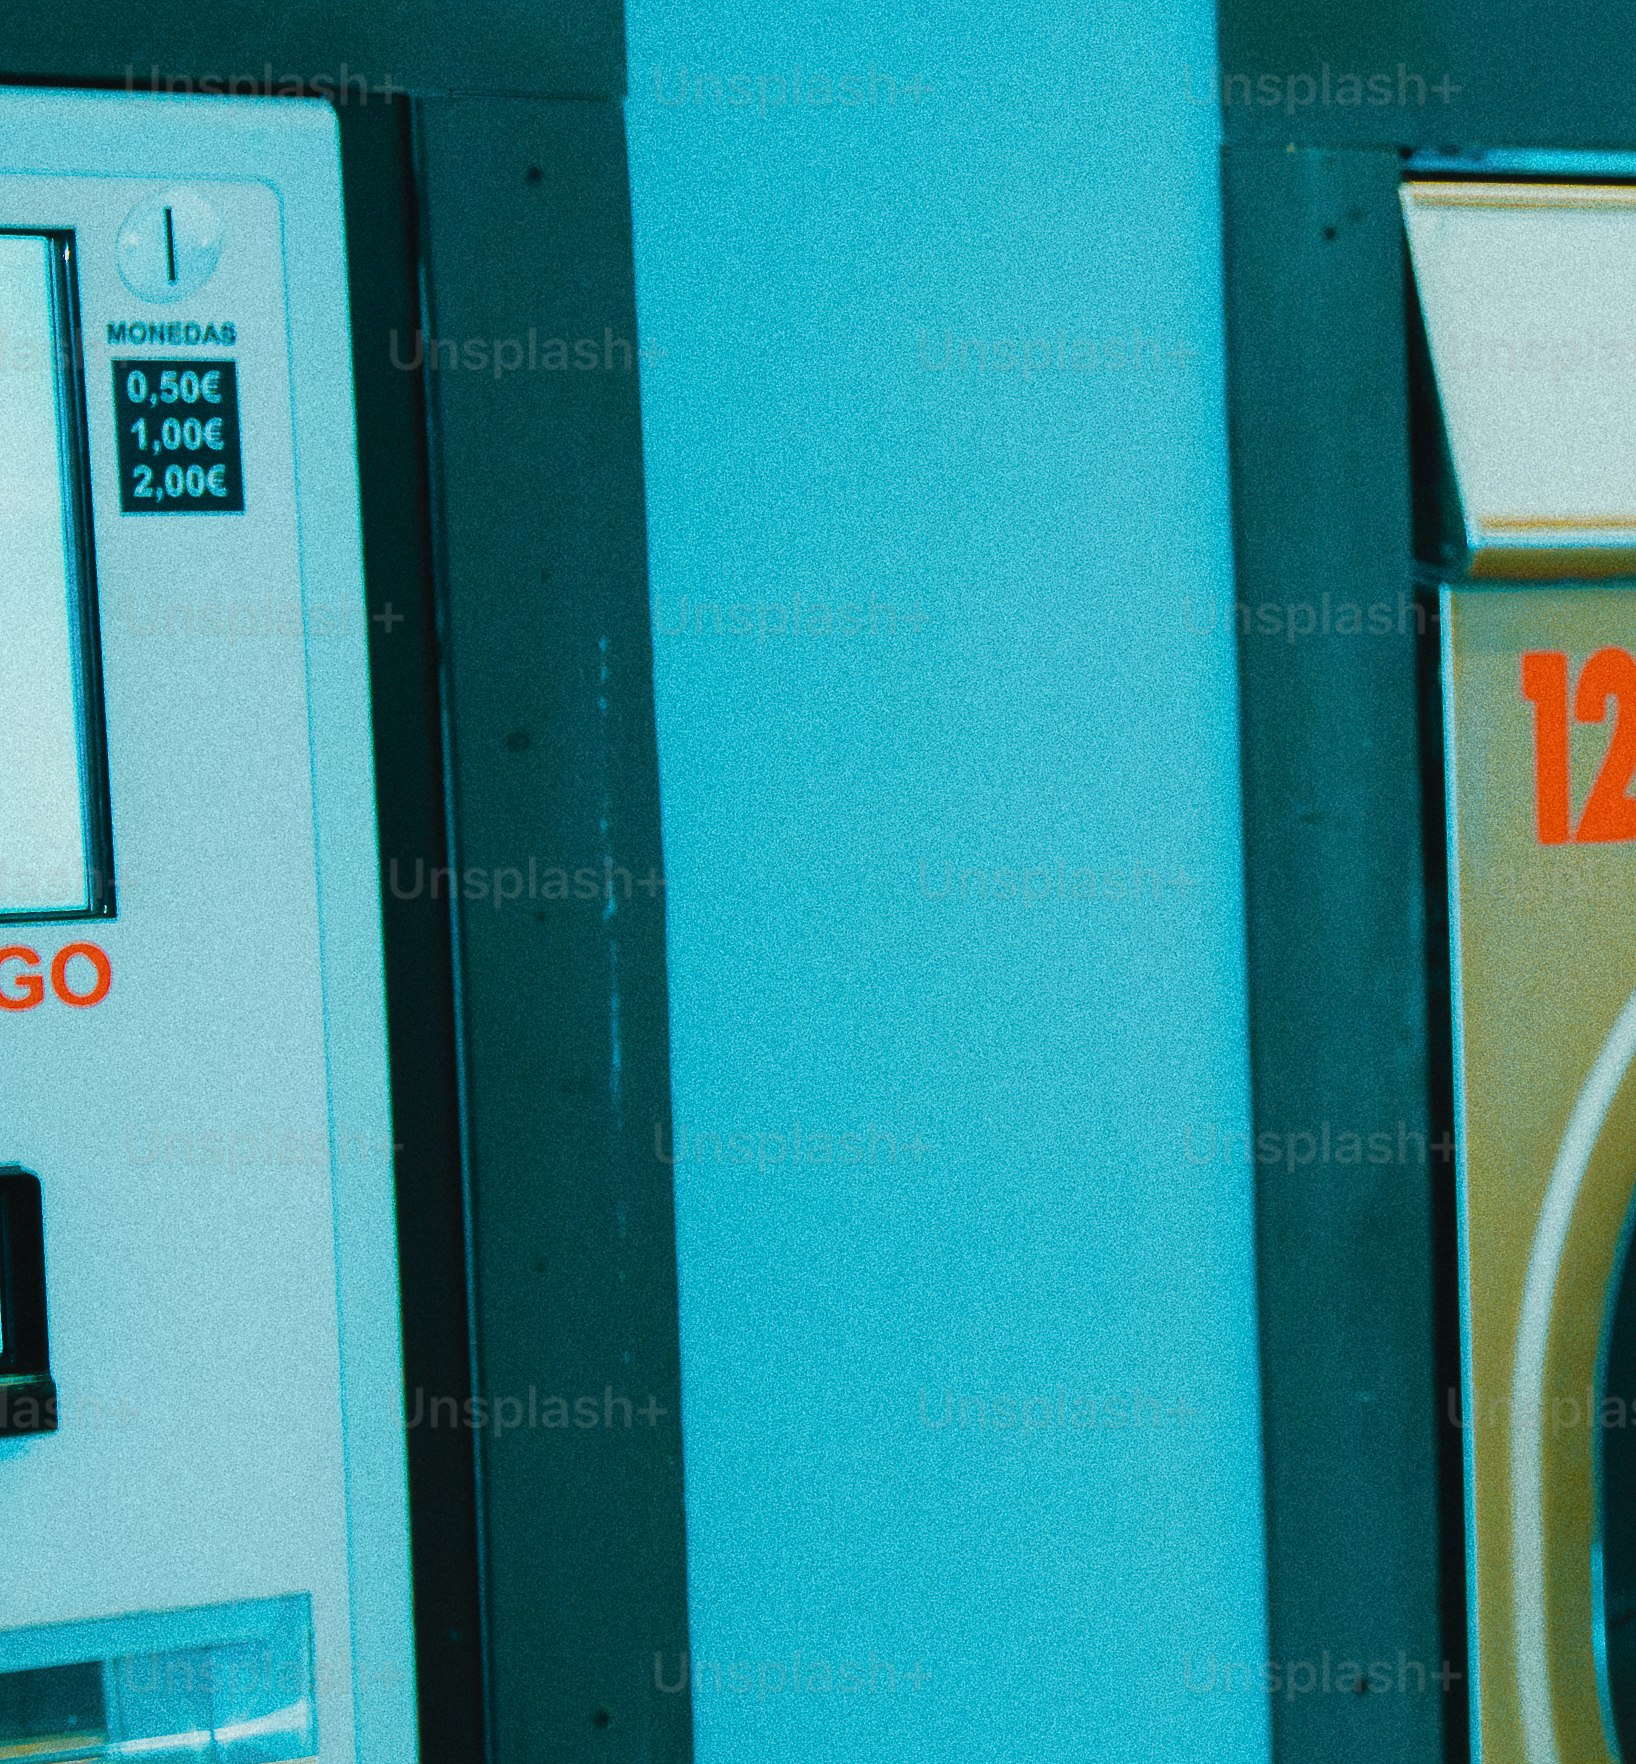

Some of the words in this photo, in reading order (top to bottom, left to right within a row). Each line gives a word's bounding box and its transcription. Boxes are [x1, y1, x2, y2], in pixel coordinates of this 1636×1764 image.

[106, 320, 238, 346] MONEDAS
[126, 369, 223, 408] 0,50€
[131, 417, 226, 457] 1,00€
[132, 463, 228, 503] 2,00€
